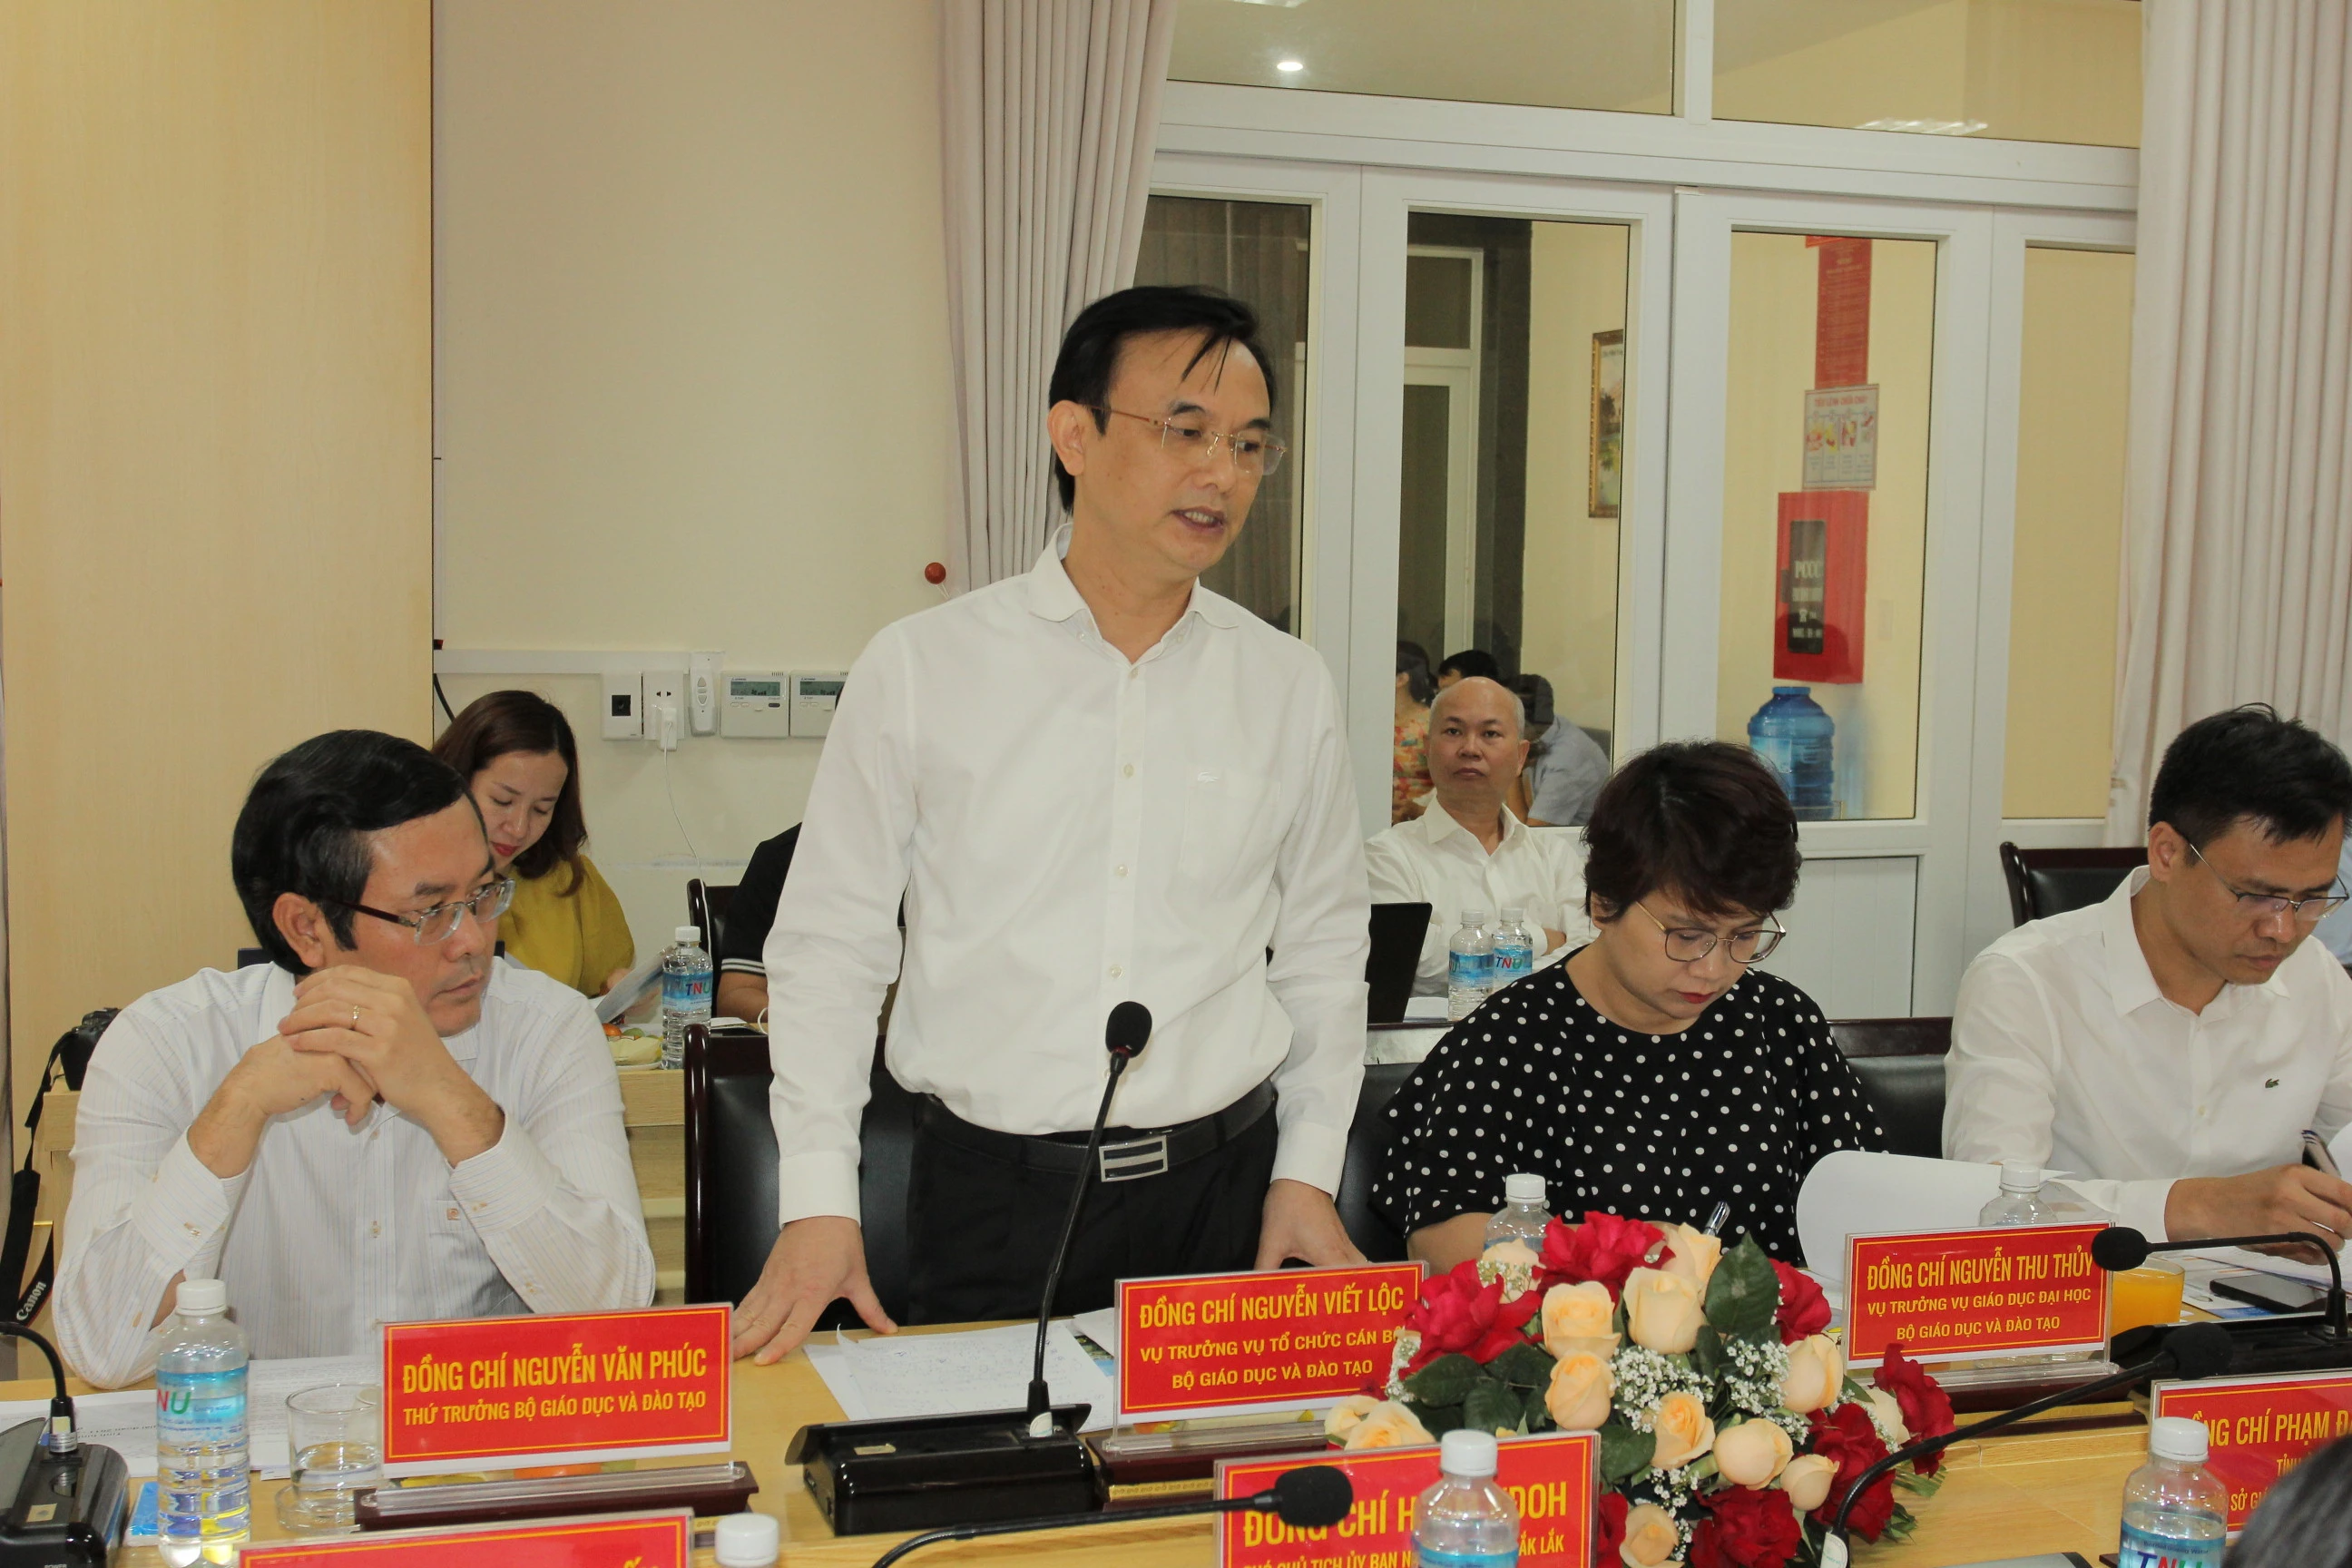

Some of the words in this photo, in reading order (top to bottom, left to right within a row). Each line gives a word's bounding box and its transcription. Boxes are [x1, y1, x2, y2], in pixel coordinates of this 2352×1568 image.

[1495, 956, 1522, 969] TNU
[685, 982, 711, 996] TNU
[1867, 1255, 1913, 1290] ĐỒNG
[1917, 1254, 1946, 1288] CHÍ
[1949, 1246, 2012, 1286] NGUYỄN
[2016, 1254, 2049, 1280] THU
[2053, 1244, 2093, 1279] THỦY
[16, 1281, 46, 1320] Canon
[1139, 1295, 1196, 1328] ĐỒNG
[1201, 1292, 1237, 1324] CHÍ
[1241, 1283, 1318, 1321] NGUYỄN
[1323, 1281, 1363, 1315] VIẾT
[1368, 1281, 1404, 1316] LỘC
[1867, 1301, 1886, 1318] VỤ
[1889, 1296, 1947, 1314] TRƯỞNG
[1951, 1296, 1969, 1312] VỤ
[1973, 1292, 2004, 1308] GIÁO
[2007, 1291, 2035, 1308] DỤC
[2038, 1289, 2060, 1306] ĐẠI
[2063, 1288, 2092, 1304] HỌC
[1140, 1347, 1163, 1364] VỤ
[1167, 1338, 1238, 1360] TRƯỞNG
[1242, 1338, 1265, 1356] VỤ
[1269, 1331, 1290, 1352] TỔ
[1294, 1330, 1341, 1350] CHỨC
[1346, 1328, 1377, 1347] CÁN
[1896, 1323, 1916, 1342] BỘ
[1918, 1321, 1951, 1338] GIÁO
[1954, 1321, 1982, 1338] DỤC
[1985, 1318, 2003, 1334] VÀ
[2005, 1316, 2033, 1332] ĐÀO
[2035, 1316, 2061, 1332] TẠO
[402, 1353, 464, 1394] ĐỒNG
[469, 1351, 507, 1390] CHÍ
[513, 1342, 596, 1387] NGUYỄN
[602, 1345, 643, 1382] VĂN
[649, 1341, 707, 1379] PHÚC
[1172, 1370, 1195, 1391] BỘ
[1200, 1367, 1239, 1387] GIÁO
[1243, 1367, 1277, 1386] DỤC
[1281, 1362, 1302, 1380] VÀ
[1306, 1360, 1338, 1378] ĐÀO
[1342, 1359, 1373, 1377] TẠO
[157, 1388, 191, 1415] NU
[403, 1402, 439, 1426] THỨ
[442, 1398, 510, 1424] TRƯỞNG
[514, 1396, 536, 1422] BỘ
[540, 1395, 578, 1417] GIÁO
[582, 1396, 615, 1417] DỤC
[618, 1390, 639, 1413] VÀ
[642, 1388, 674, 1411] ĐÀO
[677, 1390, 707, 1412] TẠO
[2191, 1410, 2230, 1447] NG
[2235, 1407, 2272, 1446] CHÍ
[2275, 1410, 2330, 1446] PHẠM
[1337, 1489, 1390, 1538] CHÍ
[2230, 1487, 2249, 1512] SỞ
[1370, 1551, 1398, 1568] BAN
[1540, 1527, 1565, 1554] LẮK
